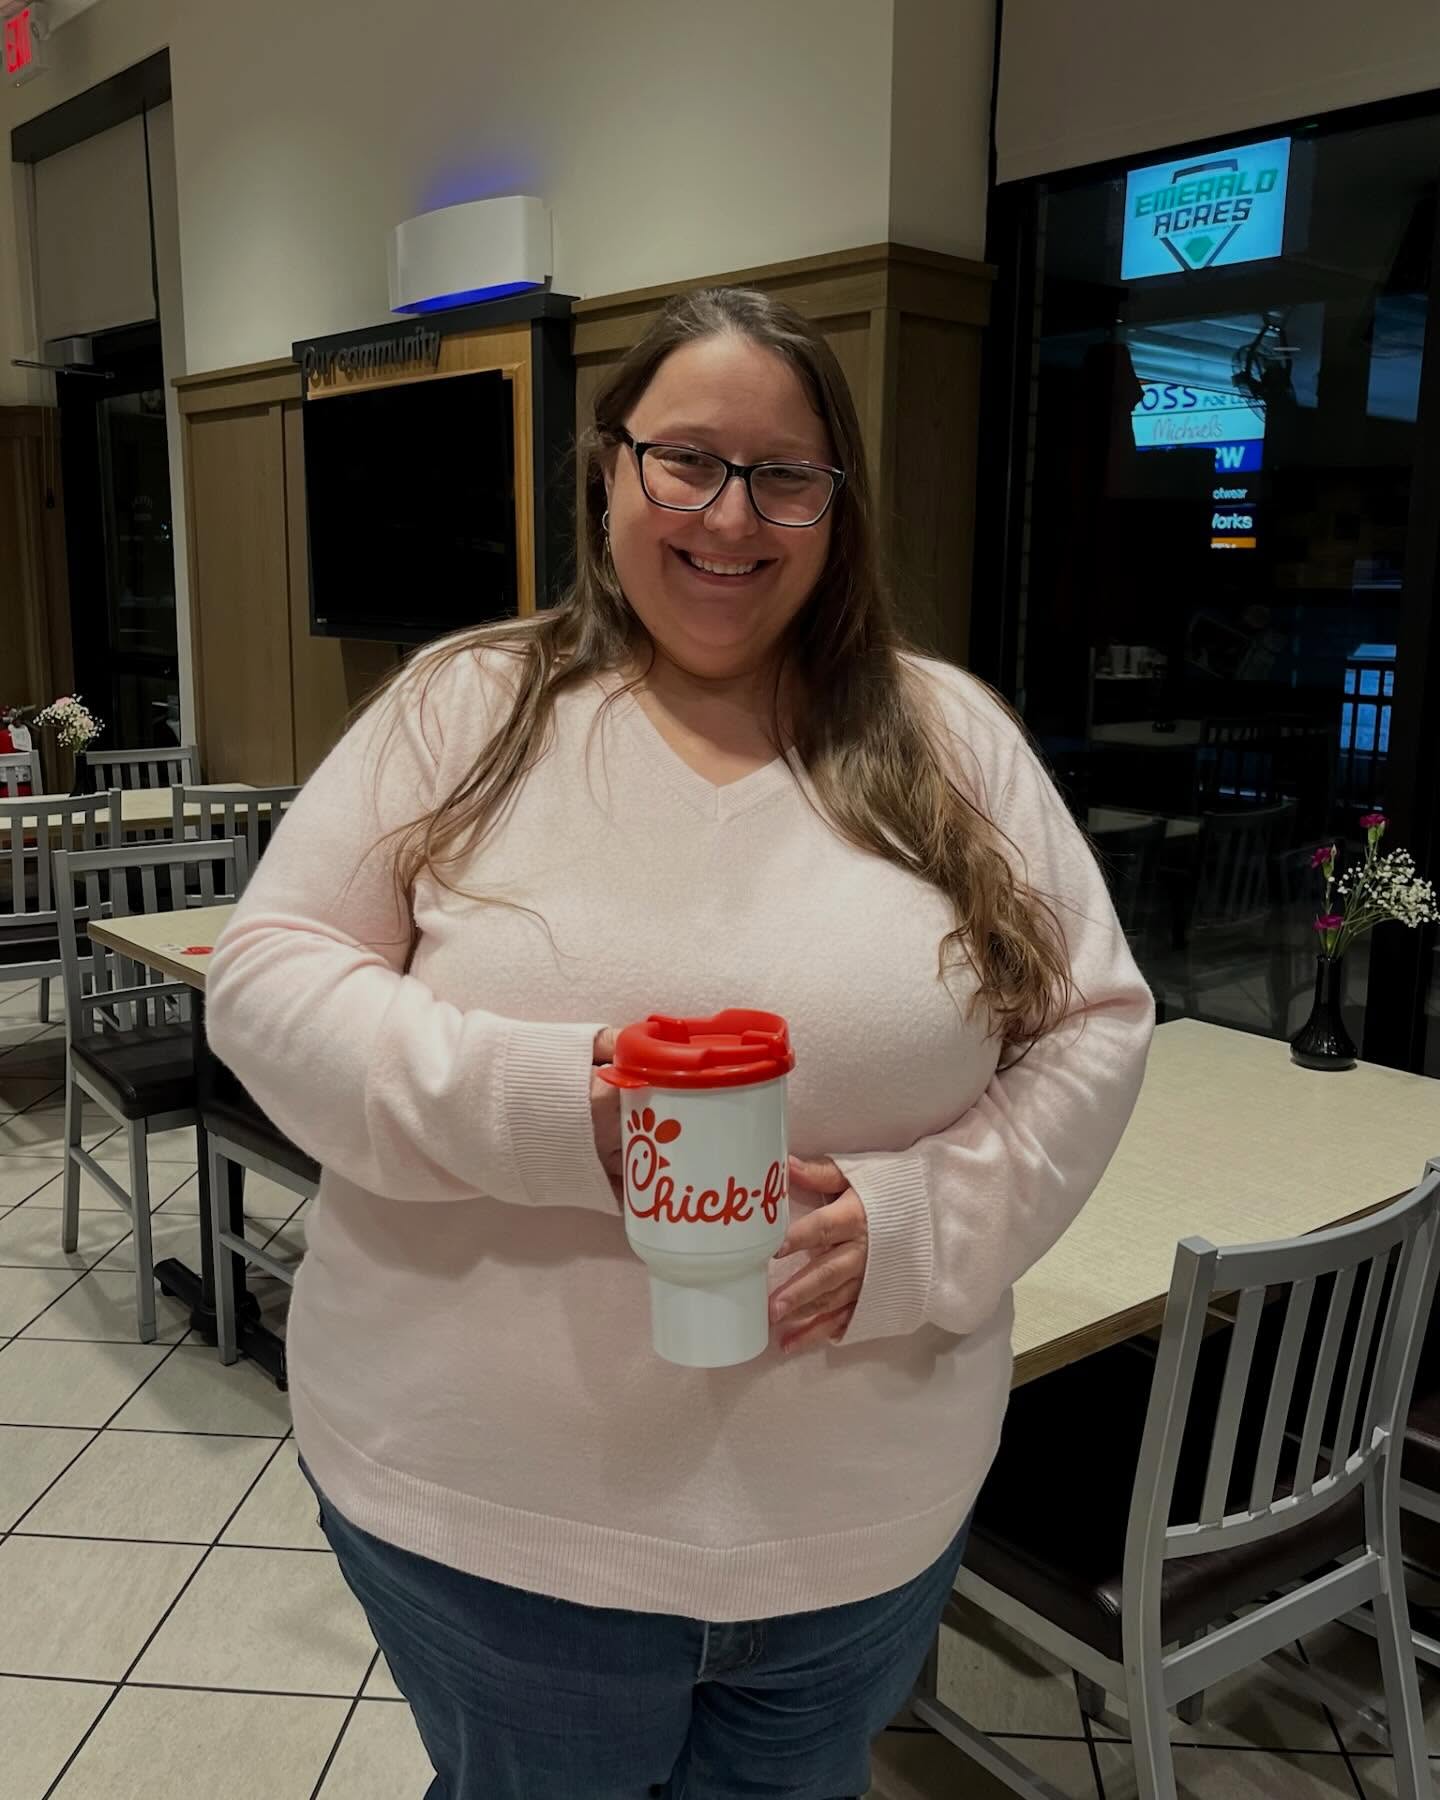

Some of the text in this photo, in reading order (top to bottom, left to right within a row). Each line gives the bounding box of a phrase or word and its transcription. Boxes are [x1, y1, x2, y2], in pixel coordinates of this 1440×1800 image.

[1135, 168, 1279, 218] EMERALD
[1153, 197, 1254, 237] ACRES
[337, 326, 441, 374] community
[1153, 414, 1224, 442] Michaels
